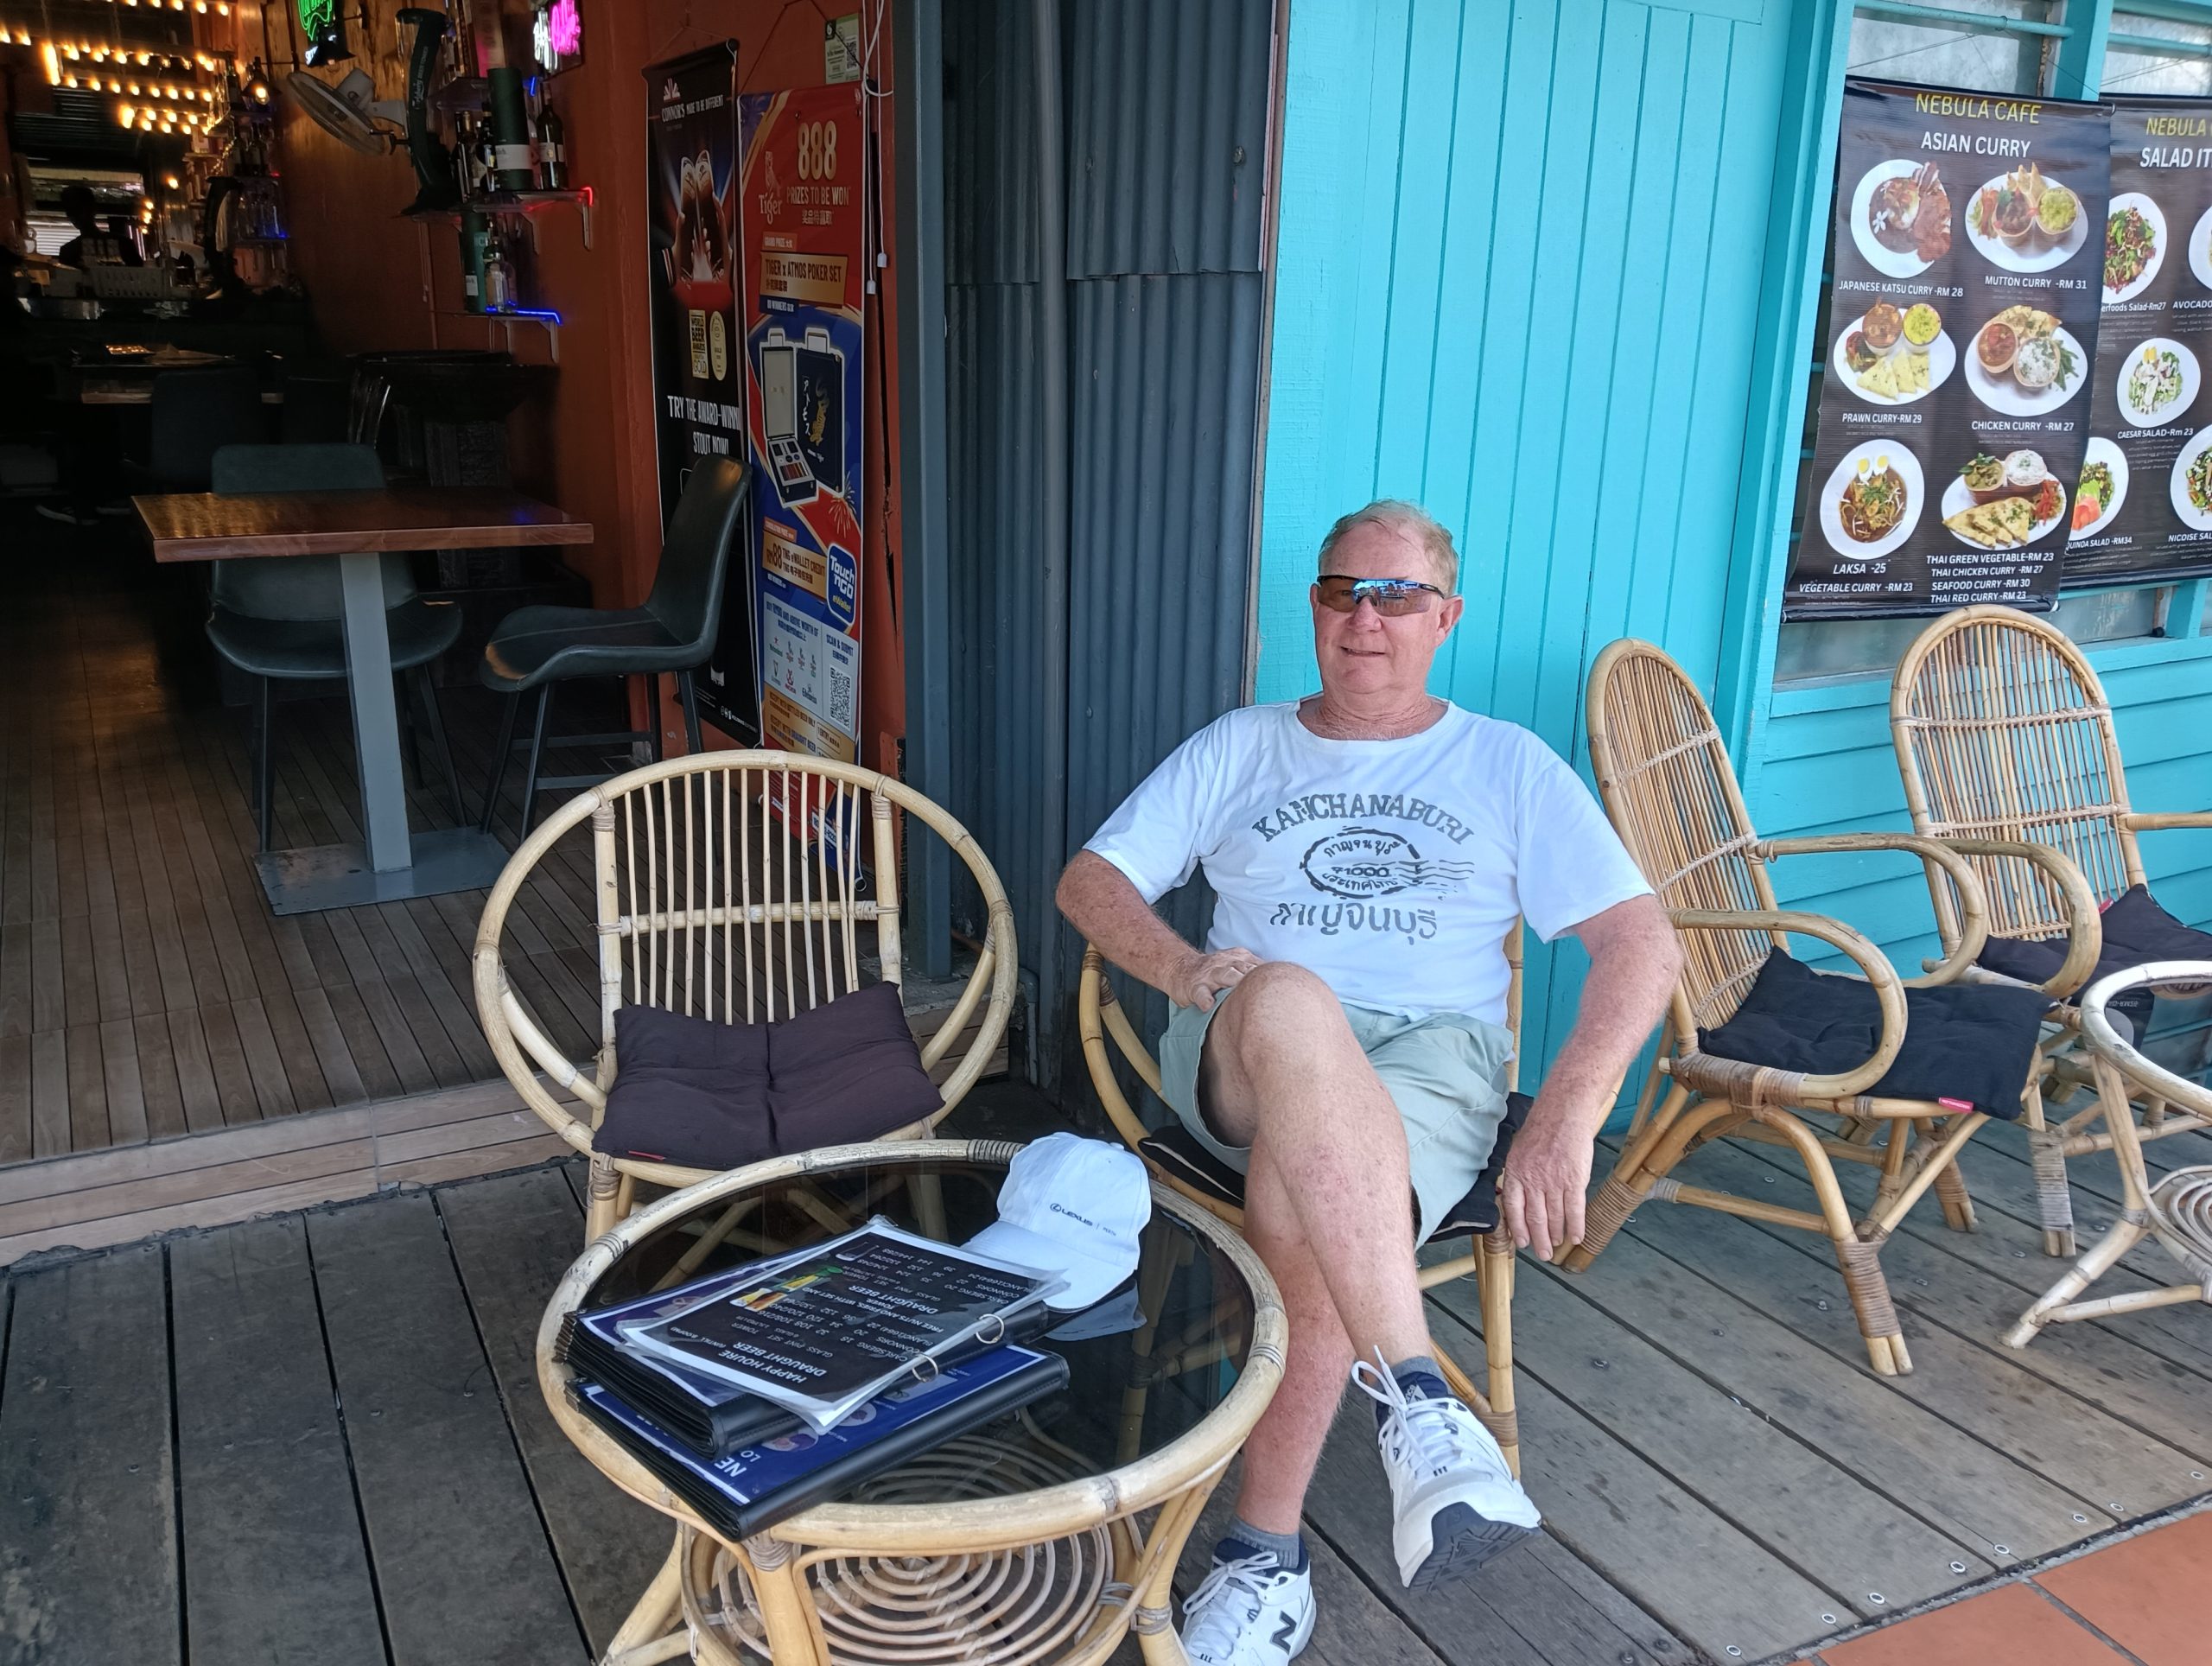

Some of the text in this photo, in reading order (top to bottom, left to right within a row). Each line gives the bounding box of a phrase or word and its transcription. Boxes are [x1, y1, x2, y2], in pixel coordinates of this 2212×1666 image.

[1916, 93, 2042, 124] NEBULA CAFE
[2145, 118, 2206, 137] NEBULA
[798, 121, 837, 180] 888
[1921, 131, 2031, 158] ASIAN CURRY
[2139, 147, 2194, 168] SALAD
[786, 186, 809, 205] PRIZES
[810, 186, 820, 205] TO
[821, 186, 830, 206] BE
[758, 192, 783, 225] Tiger
[766, 258, 781, 277] TIGER
[787, 261, 806, 279] ATMOS
[808, 264, 828, 282] POKER
[830, 265, 842, 283] SET
[1838, 279, 1964, 297] JAPANESE KATSU CURRY -RM 28
[1985, 276, 2088, 289] MUTTON CURRY -RM 31
[667, 395, 697, 423] TRY THE
[1842, 412, 1871, 423] PRAWN
[1913, 414, 1922, 423] 29
[1971, 420, 2075, 432] CHICKEN CURRY -RM 27
[2117, 429, 2141, 439] CAESAR
[2183, 428, 2194, 436] 23
[693, 431, 711, 455] STOUT
[2089, 538, 2110, 547] SALAD
[2111, 536, 2133, 546] -RM34
[2168, 533, 2198, 543] NICOISE
[1926, 555, 1948, 564] THAI
[1948, 555, 1979, 564] GREEN
[2043, 552, 2055, 561] 23
[830, 556, 855, 585] Touch
[1833, 563, 1886, 575] LAKSA -25
[1931, 565, 2044, 577] THAI CHICKEN CURRY -RM 27
[1799, 582, 1913, 593] VEGETABLE CURRY -RM 23
[1931, 578, 2031, 591] SEAFOOD CURRY -RM 30
[832, 595, 851, 614] eWallet
[1930, 595, 1951, 603] THAI
[1952, 594, 1969, 602] RED
[1970, 592, 1999, 601] CURRY
[2017, 591, 2026, 600] 23
[1252, 793, 1474, 845] KANCHANABURI
[1269, 901, 1437, 945] กาญจนบุรี
[1061, 1208, 1094, 1226] LEXUS
[846, 1285, 939, 1313] DRAUGHT BEER
[913, 1292, 942, 1300] GLASS
[956, 1288, 1010, 1304] CARLSBERG
[974, 1284, 1020, 1298] CONNORS
[755, 1310, 794, 1323] 108/216
[897, 1315, 923, 1325] NUTS
[729, 1322, 761, 1333] TOWER
[919, 1322, 944, 1332] FREE
[782, 1339, 807, 1348] PINT
[855, 1341, 909, 1361] CARLSBERG
[874, 1336, 922, 1353] CONNORS
[730, 1341, 828, 1376] DRAUGHT BEER
[804, 1346, 835, 1358] GLASS
[717, 1350, 807, 1383] HAPPY HOURE
